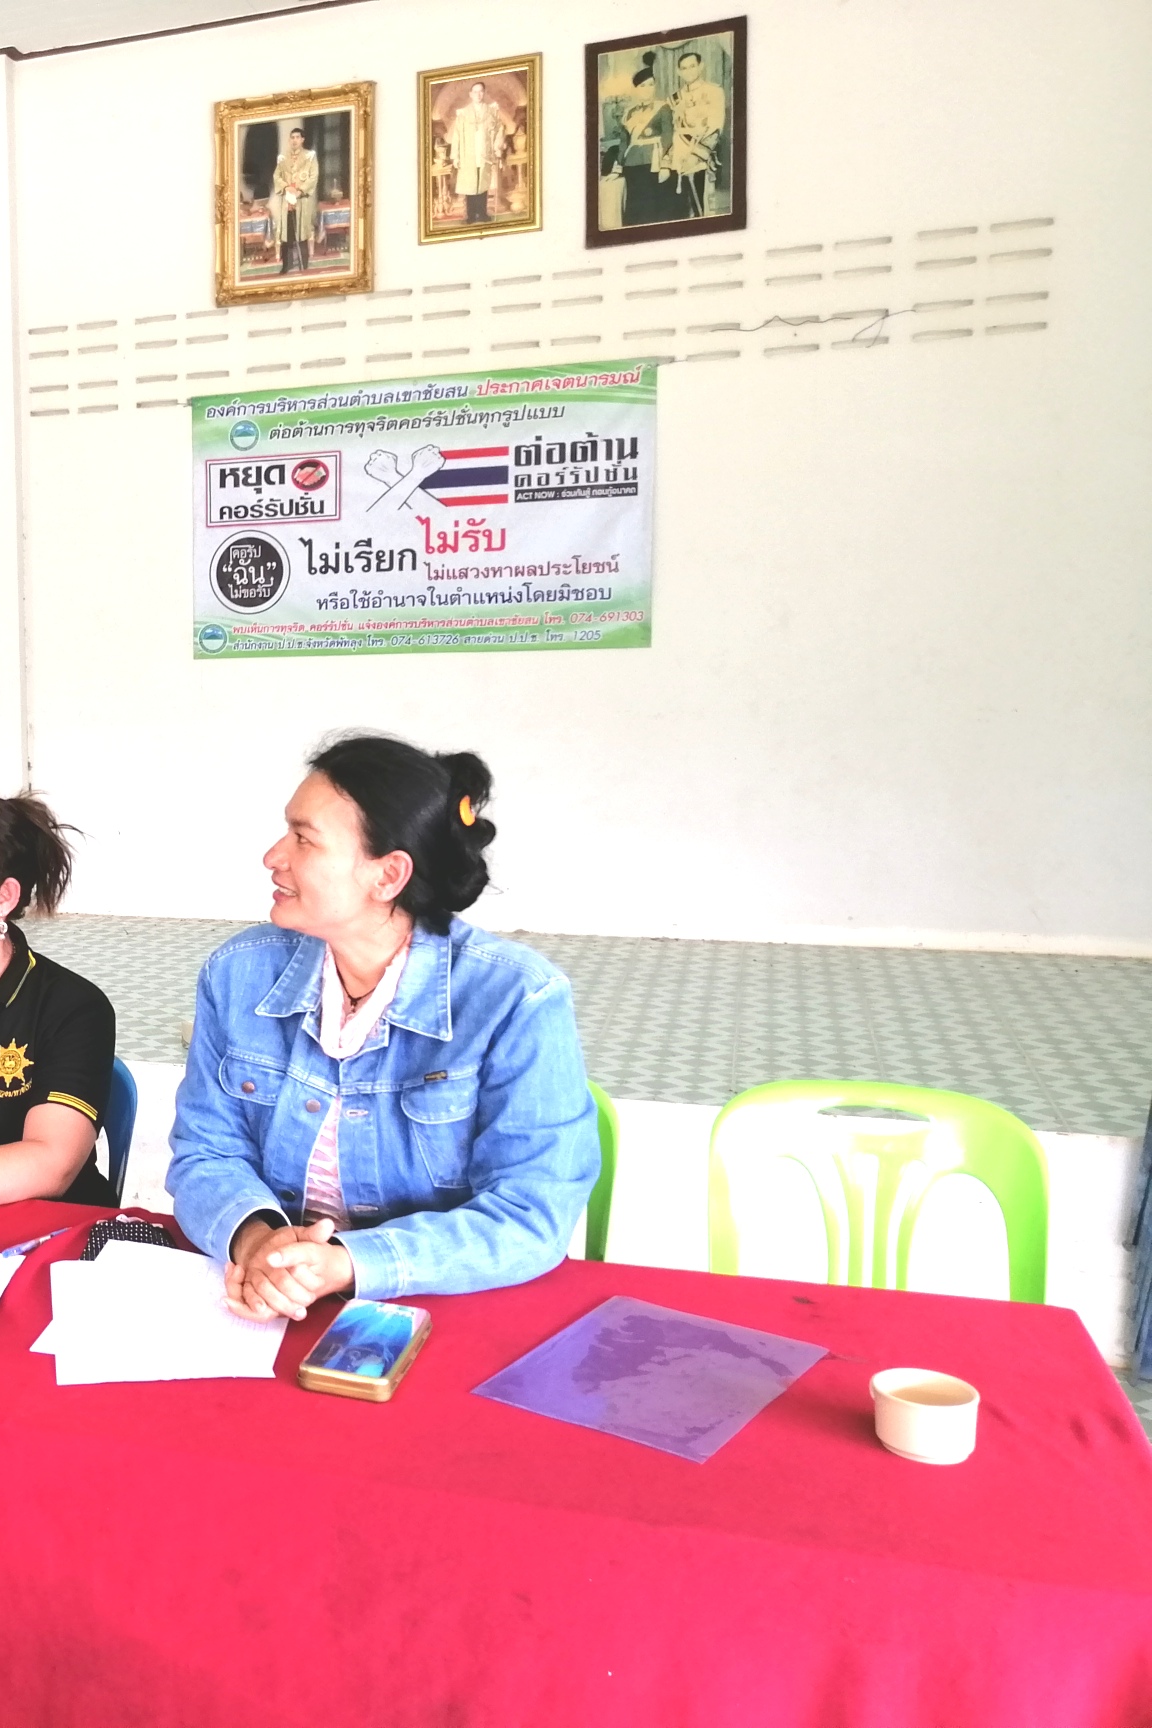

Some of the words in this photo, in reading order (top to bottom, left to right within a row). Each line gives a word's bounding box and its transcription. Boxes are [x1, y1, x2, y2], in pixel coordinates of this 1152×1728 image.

[206, 384, 468, 419] องค์การบริหารส่วนตำบลเขาชัยสน
[477, 364, 642, 396] ประกาศเจตนารมณ์
[269, 404, 565, 440] ต่อต้านการทุจริตคอร์รัปชั่นทุกรูปแบบ
[514, 432, 639, 466] ต่อต้าน
[219, 464, 286, 493] หยุด
[514, 460, 638, 488] คอร์รัปชั่น
[219, 493, 324, 519] คอร์รัปชั่น
[516, 492, 533, 500] ACT
[535, 491, 555, 499] NOW
[416, 515, 507, 555] ไม่รับ
[298, 537, 417, 576] ไม่เรียก
[424, 554, 620, 581] ไม่แสวงหาผลประโยชน์
[316, 582, 612, 611] หรือใช้อำนาจในตำแหน่งโดยมิชอบ
[570, 611, 645, 624] 074-691303
[391, 634, 460, 646] 074-613726
[573, 630, 602, 641] 1205
